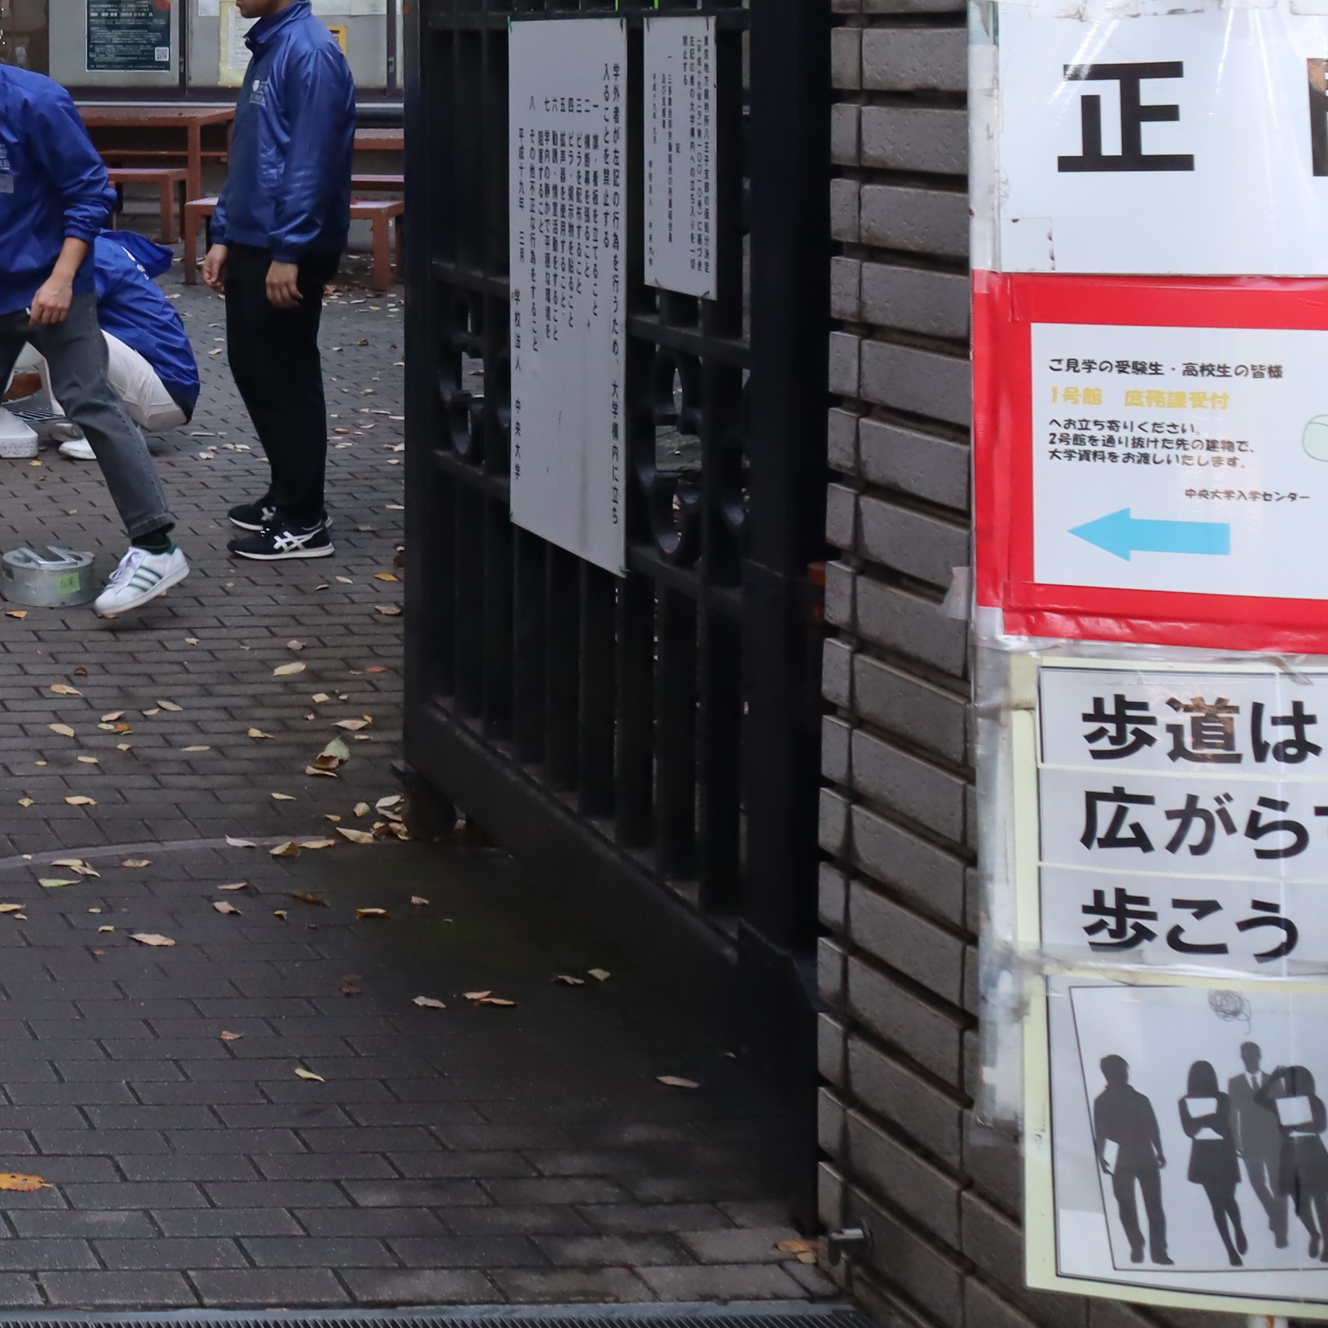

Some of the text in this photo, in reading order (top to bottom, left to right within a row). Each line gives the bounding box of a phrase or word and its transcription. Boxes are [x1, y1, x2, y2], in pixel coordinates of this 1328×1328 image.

[602, 62, 611, 249] 入ることを禁止する
[1048, 358, 1284, 379] ご見学の受験生・高校生の皆様
[1050, 386, 1230, 410] 1号館 庶務課受付
[514, 397, 522, 480] 中央大学
[1048, 418, 1201, 436] へお立ち寄りください。
[1048, 433, 1256, 453] 2号館を通り抜けた先の建物で、
[1048, 449, 1247, 469] 大学資料をお渡しいたします。
[1184, 488, 1311, 503] 中央大学入学センター
[1081, 693, 1323, 764] 歩道は
[1079, 785, 1328, 860] 広がら
[1081, 887, 1299, 964] 歩こう
